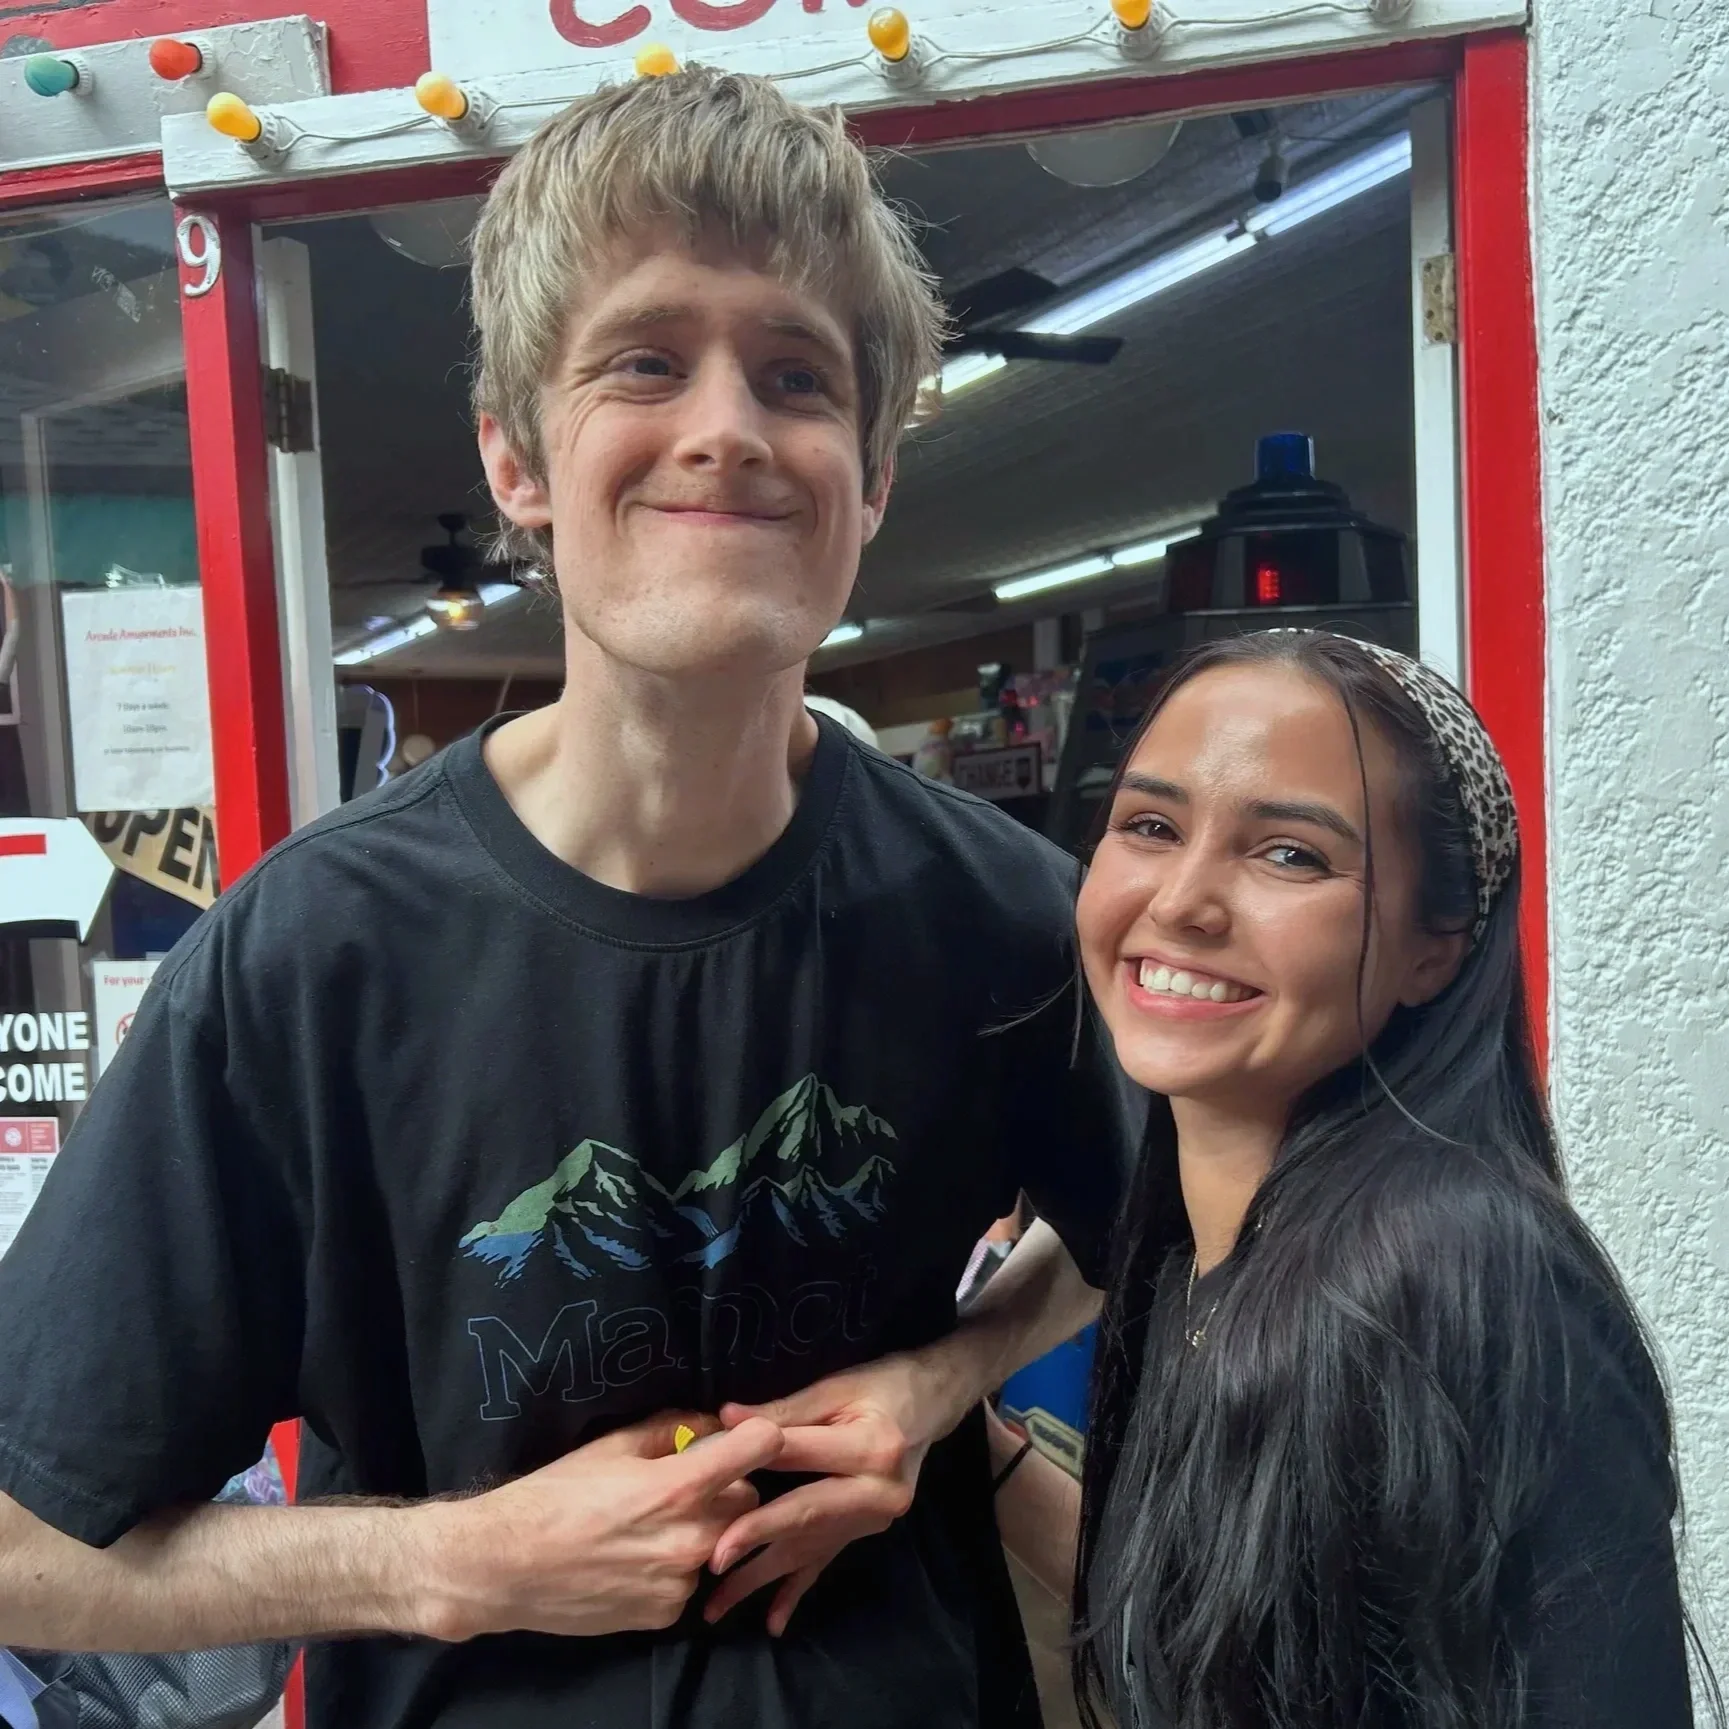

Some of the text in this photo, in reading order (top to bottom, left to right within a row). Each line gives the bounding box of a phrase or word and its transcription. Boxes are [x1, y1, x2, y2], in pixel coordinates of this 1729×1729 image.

[177, 214, 221, 297] 9
[84, 629, 118, 642] Arcade
[120, 627, 177, 643] Amusements
[94, 807, 221, 898] OPEN
[104, 975, 119, 985] For
[122, 976, 144, 987] your
[0, 1063, 86, 1103] OME
